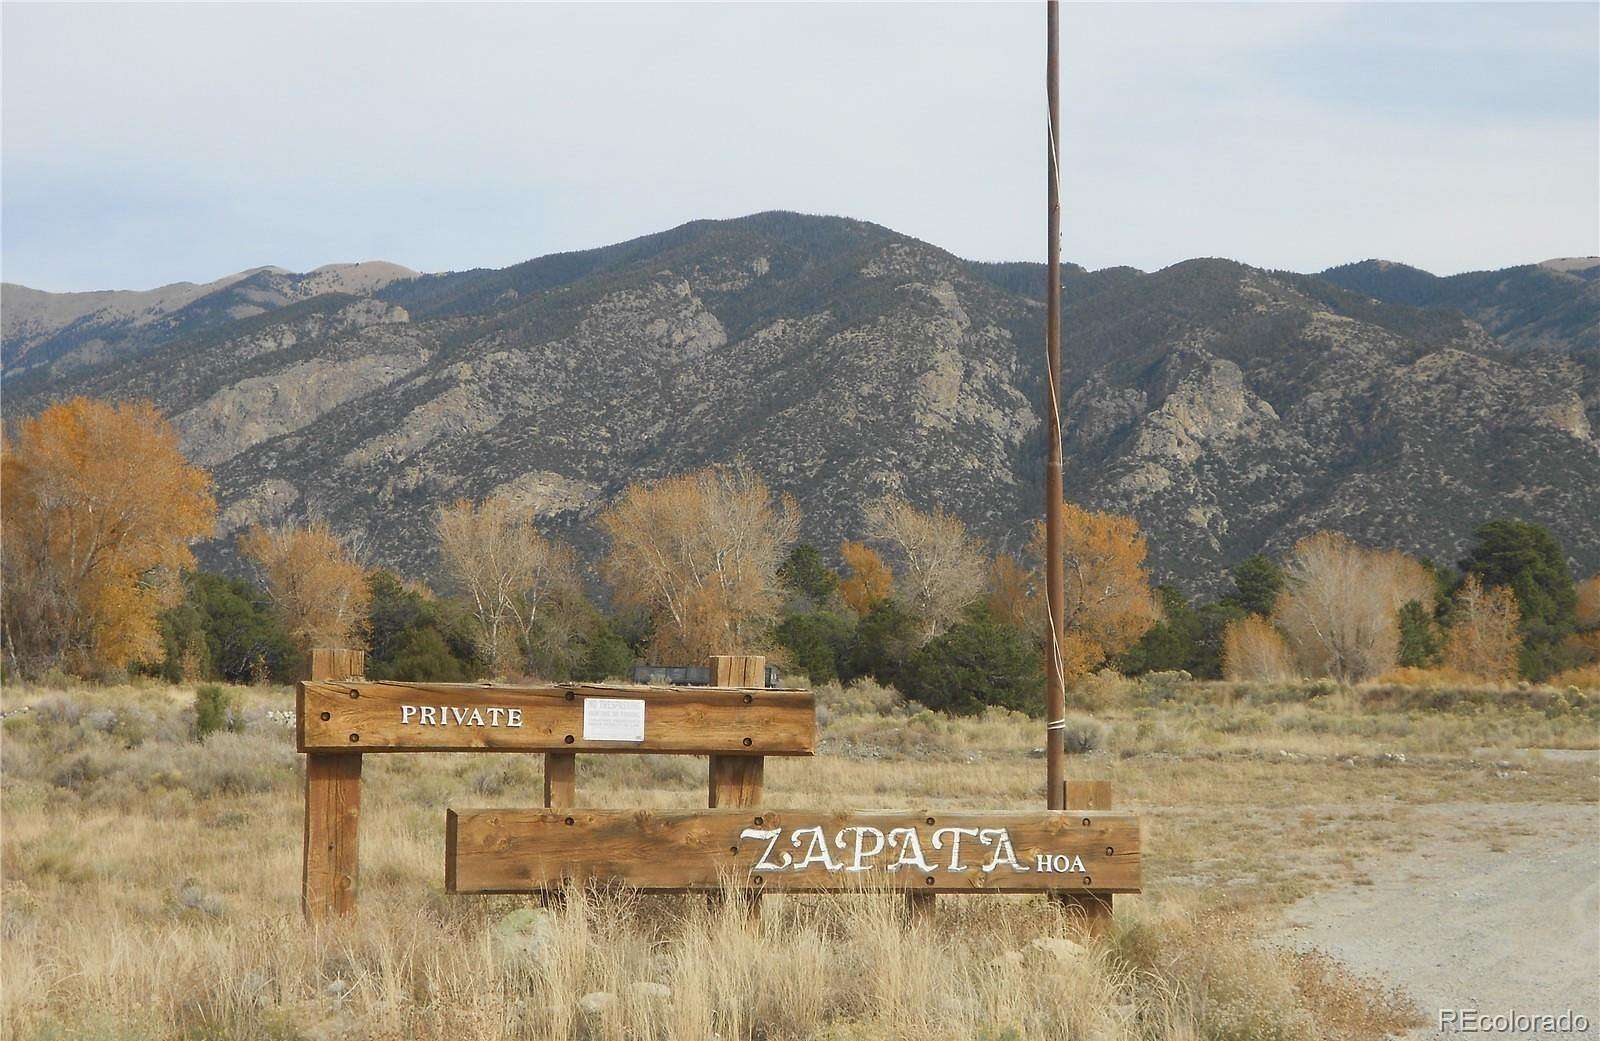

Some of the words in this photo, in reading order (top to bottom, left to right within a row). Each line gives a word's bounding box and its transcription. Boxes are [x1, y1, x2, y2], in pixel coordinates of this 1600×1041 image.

[400, 705, 523, 727] PRIVATE
[740, 825, 1030, 872] ZAPATA
[1036, 855, 1086, 872] HOA
